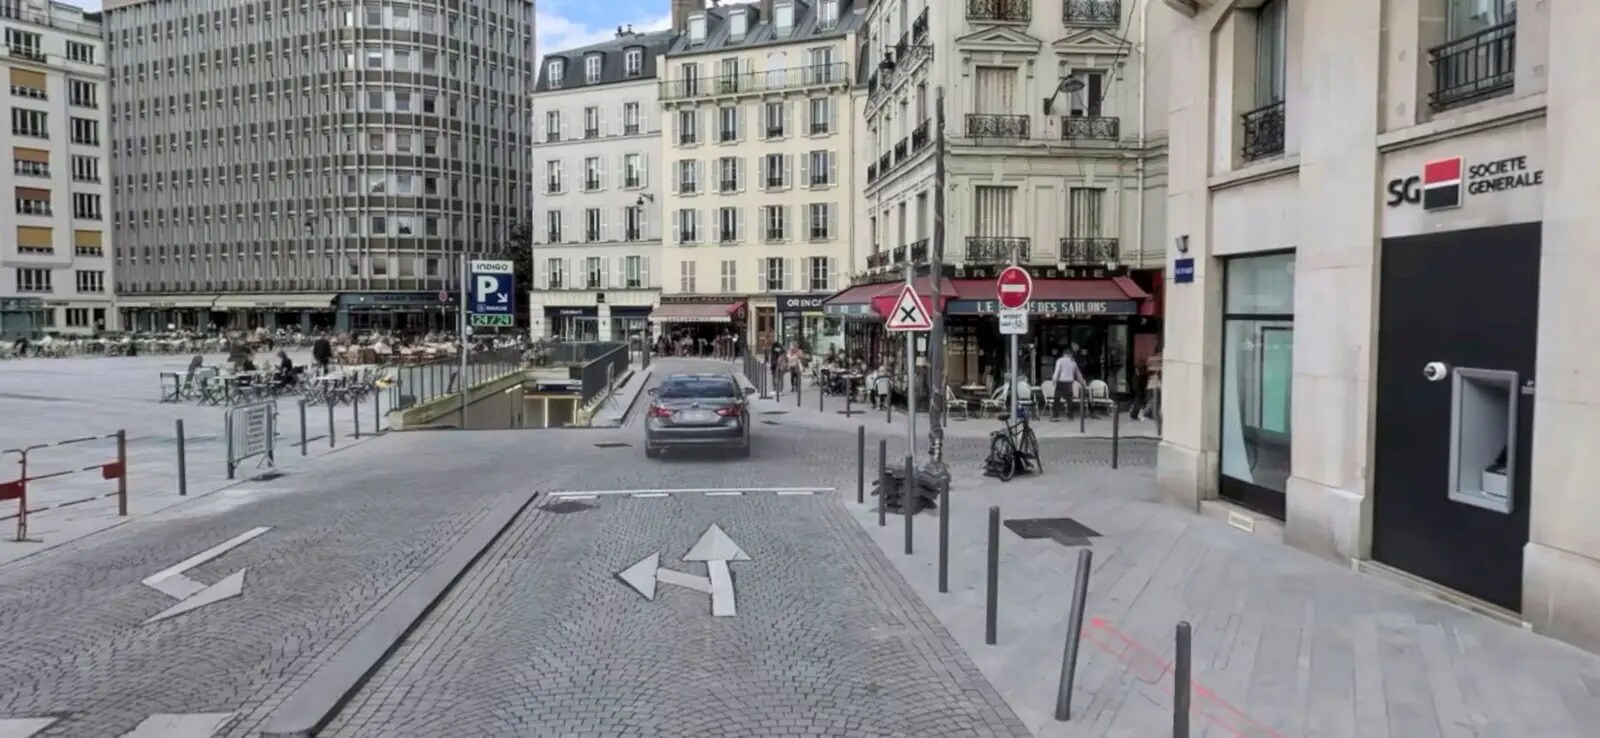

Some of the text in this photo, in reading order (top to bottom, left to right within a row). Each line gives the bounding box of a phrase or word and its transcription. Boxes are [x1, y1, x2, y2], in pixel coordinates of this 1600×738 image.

[1469, 155, 1527, 179] SOCIETE
[1386, 175, 1421, 207] SG
[1468, 170, 1544, 195] GENERALE
[476, 263, 508, 271] INDIGO
[477, 275, 499, 303] P
[977, 301, 993, 312] LE
[1038, 301, 1057, 313] DES
